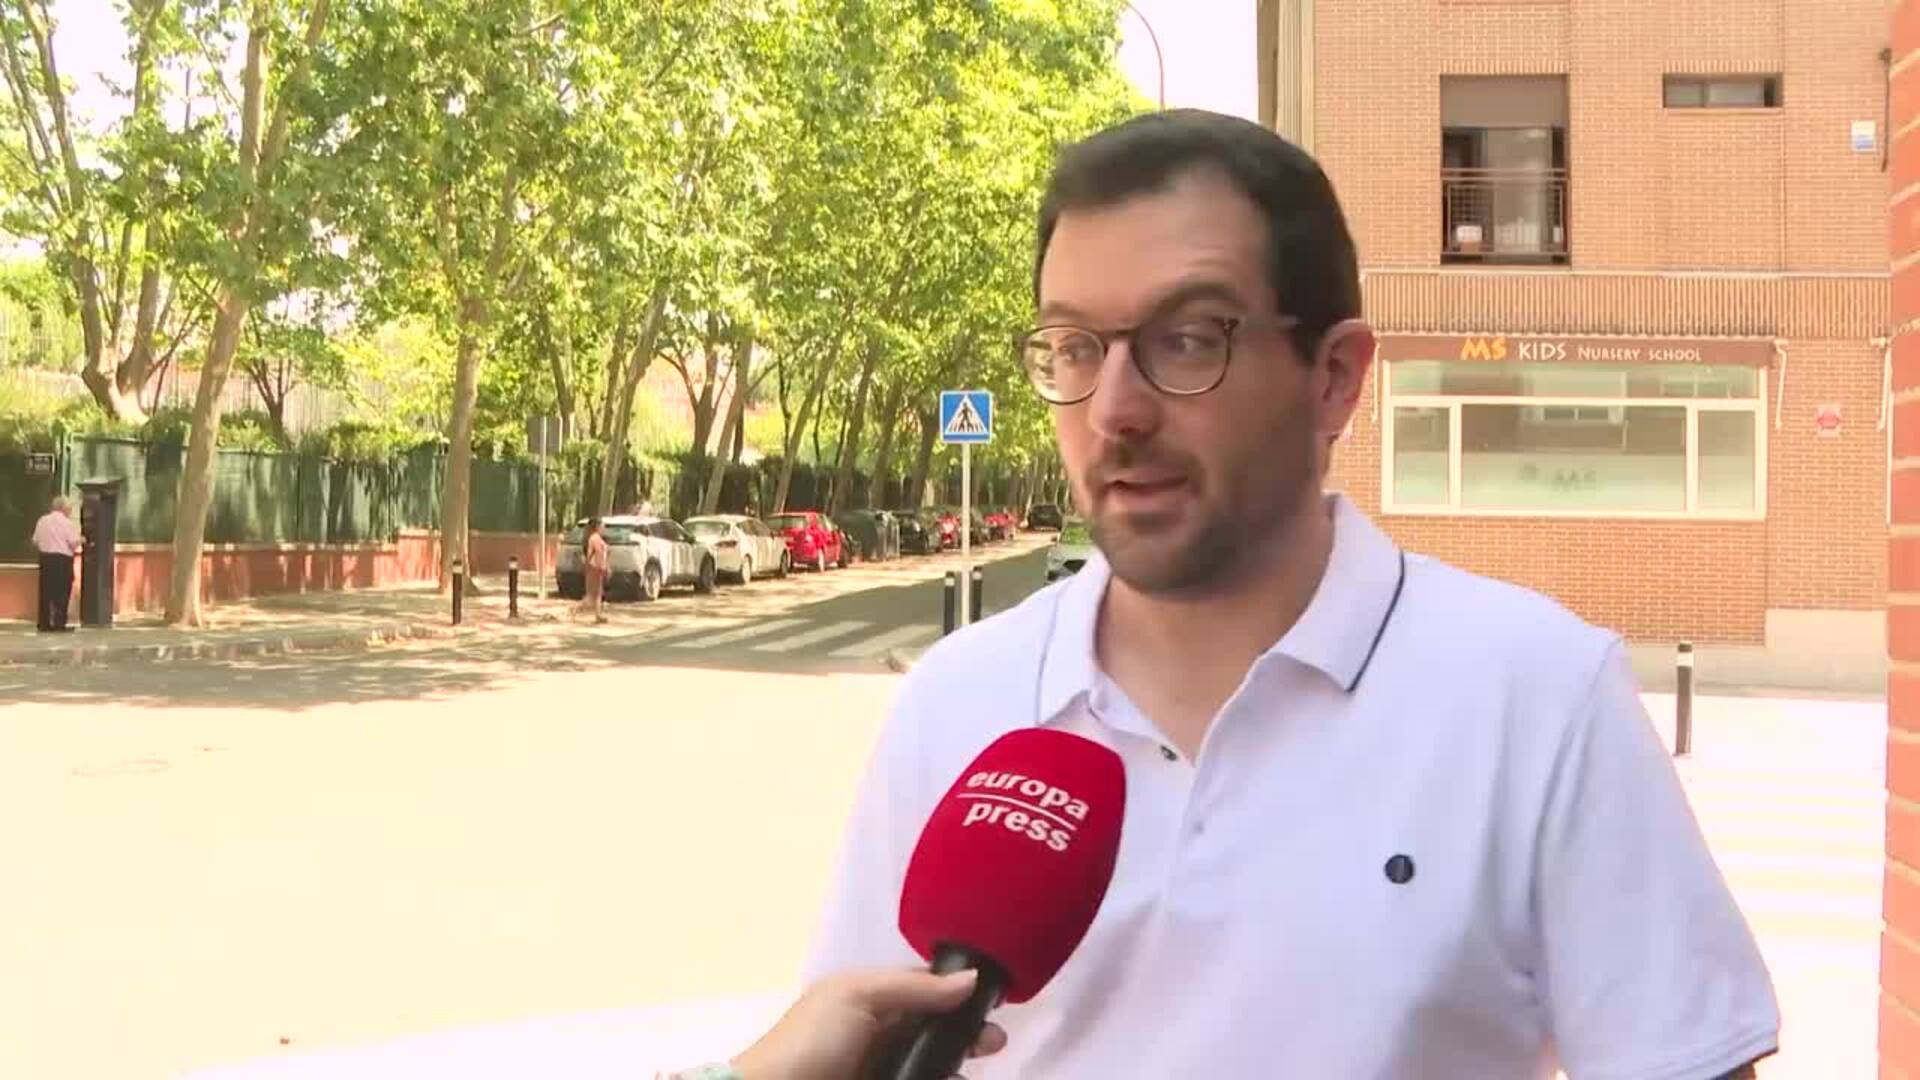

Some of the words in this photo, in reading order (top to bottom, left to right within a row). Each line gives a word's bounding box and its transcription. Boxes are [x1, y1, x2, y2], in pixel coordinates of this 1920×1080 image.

[1460, 337, 1507, 361] MS
[1519, 341, 1566, 361] KIDS
[1578, 346, 1641, 361] NURSERY
[1649, 347, 1701, 361] SCHOOL
[966, 771, 1089, 820] europa
[962, 803, 1071, 851] press
